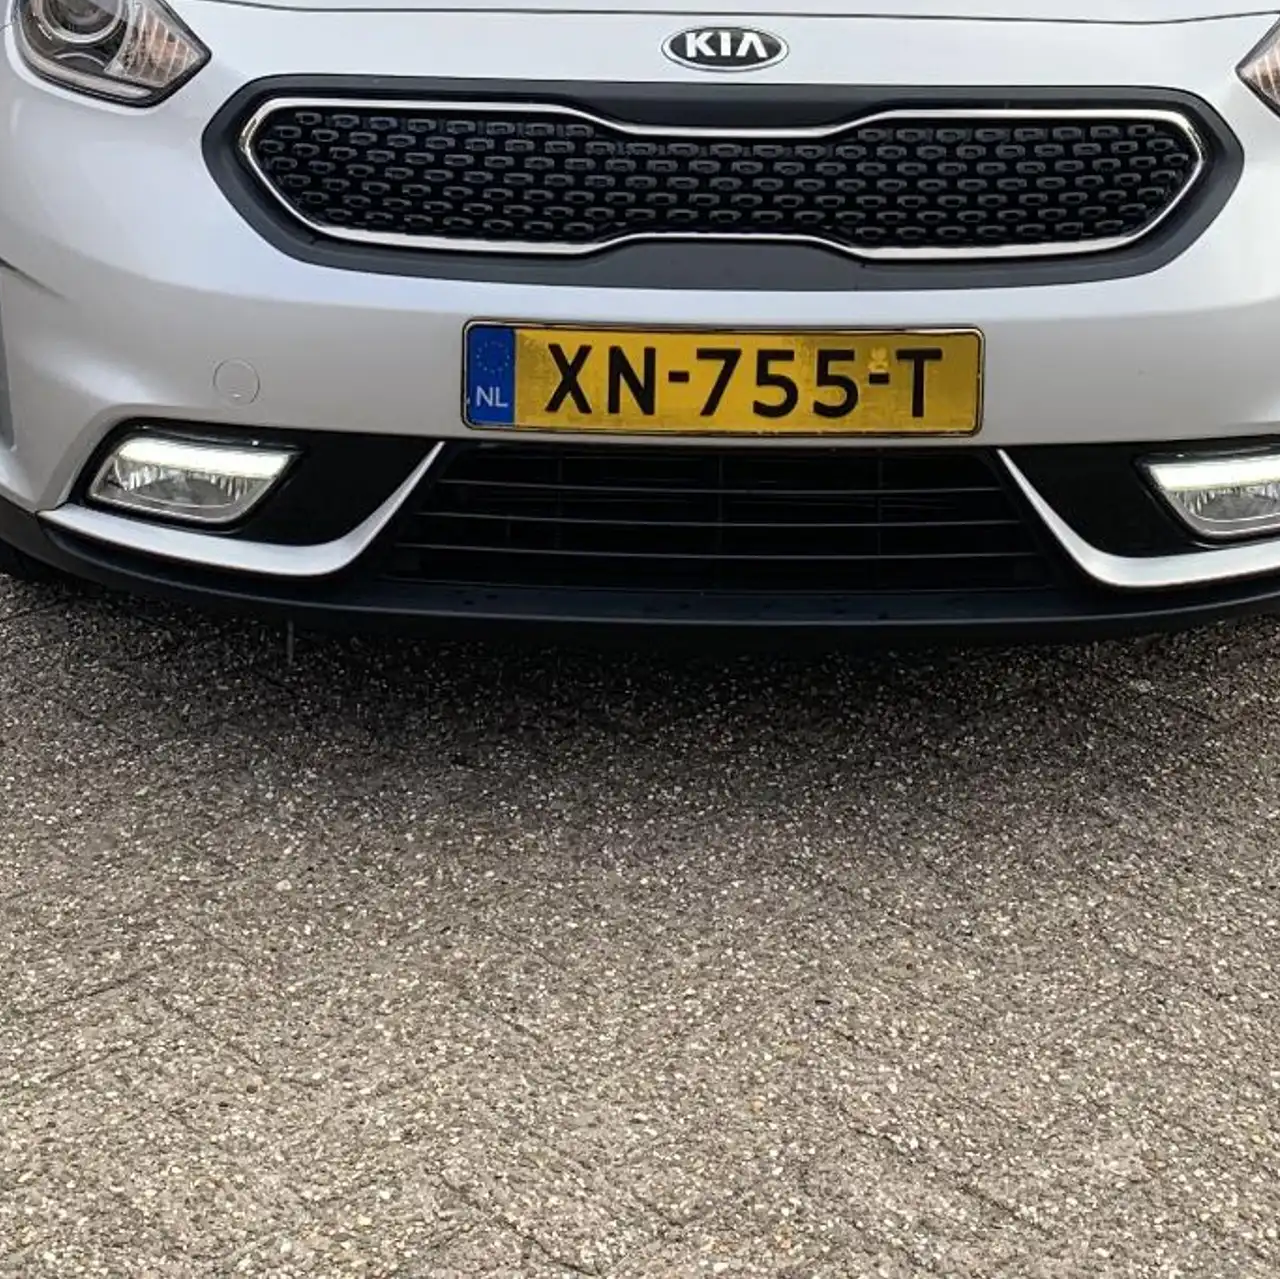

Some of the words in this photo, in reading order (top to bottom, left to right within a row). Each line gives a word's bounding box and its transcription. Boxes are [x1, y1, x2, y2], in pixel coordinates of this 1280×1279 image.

[684, 30, 768, 59] KIA
[544, 343, 944, 419] XN-755-T
[475, 385, 509, 408] NL
